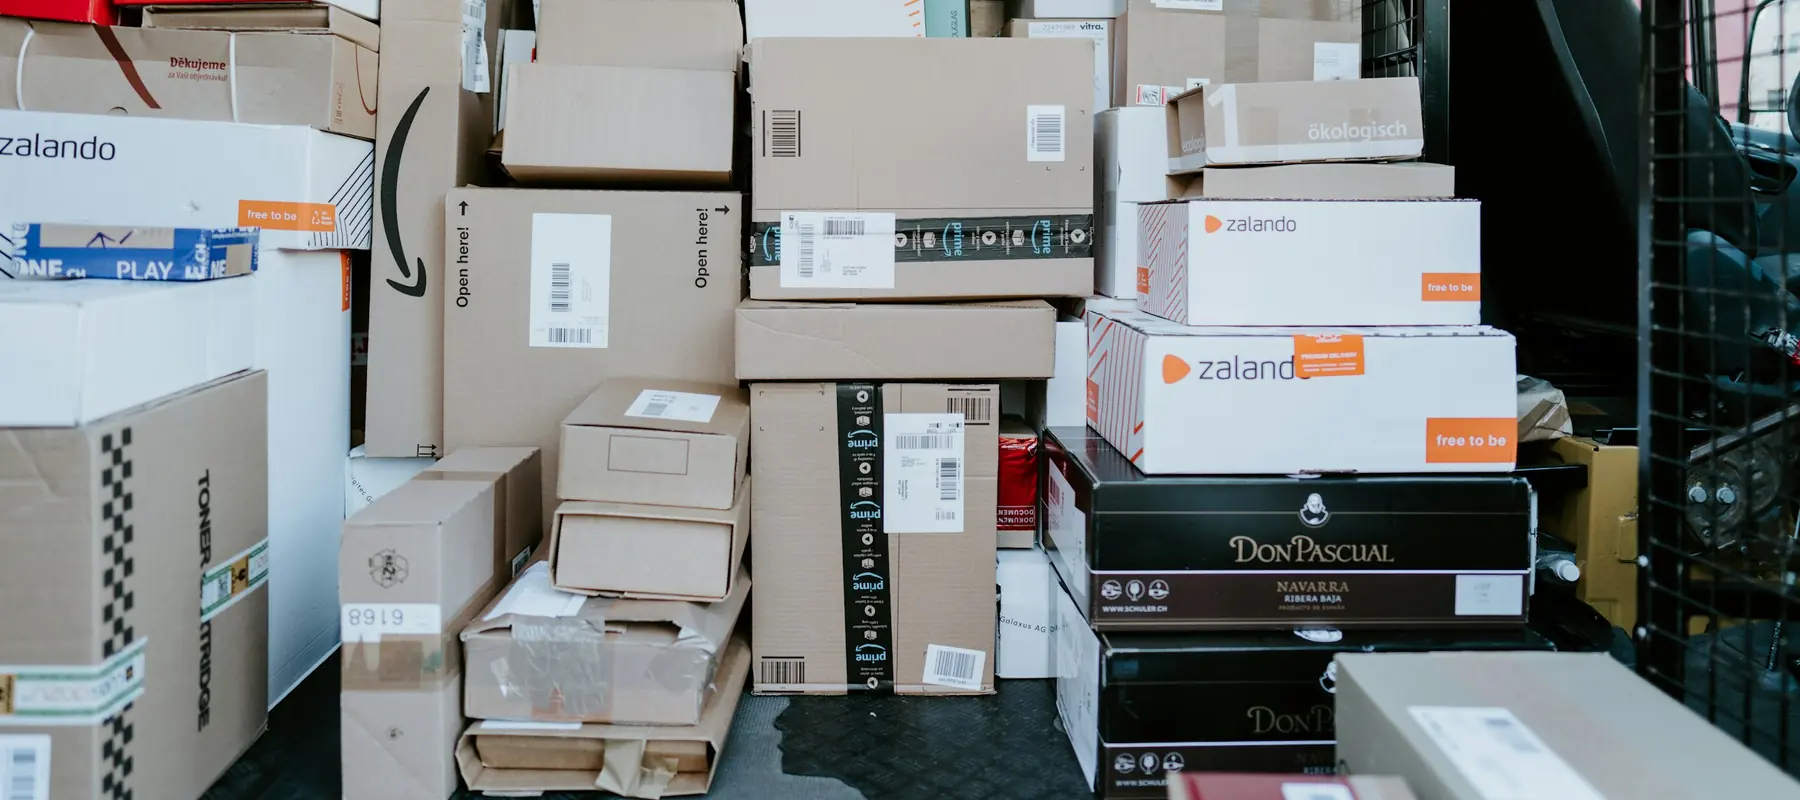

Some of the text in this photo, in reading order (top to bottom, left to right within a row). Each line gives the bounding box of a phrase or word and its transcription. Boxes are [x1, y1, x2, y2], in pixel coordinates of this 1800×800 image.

[950, 10, 958, 38] OUGLAS
[1080, 22, 1104, 30] vitra.
[170, 56, 226, 72] Děkujeme
[1308, 118, 1408, 142] ökologisch
[0, 133, 116, 161] zalando
[248, 209, 298, 221] free to be
[1227, 216, 1297, 233] zalando
[951, 222, 965, 257] prime
[1039, 219, 1053, 254] prime
[695, 207, 710, 290] Open here!
[116, 260, 174, 281] PLAY
[456, 226, 471, 308] Open here!
[1428, 284, 1473, 293] free to be
[1200, 354, 1311, 381] zaland
[848, 436, 878, 450] prime
[1436, 434, 1506, 448] free to be
[198, 469, 211, 567] TONER
[850, 507, 881, 521] prime
[996, 508, 1035, 516] DOCUMEN
[853, 578, 884, 592] prime
[1276, 580, 1350, 593] NAVARRA
[1284, 594, 1342, 604] RIBERA BAJA
[1102, 604, 1168, 613] WWW.SCHULER.CH
[348, 608, 404, 626] 6168
[999, 615, 1032, 630] Galaxus
[1034, 624, 1047, 634] AG
[855, 650, 887, 663] prime
